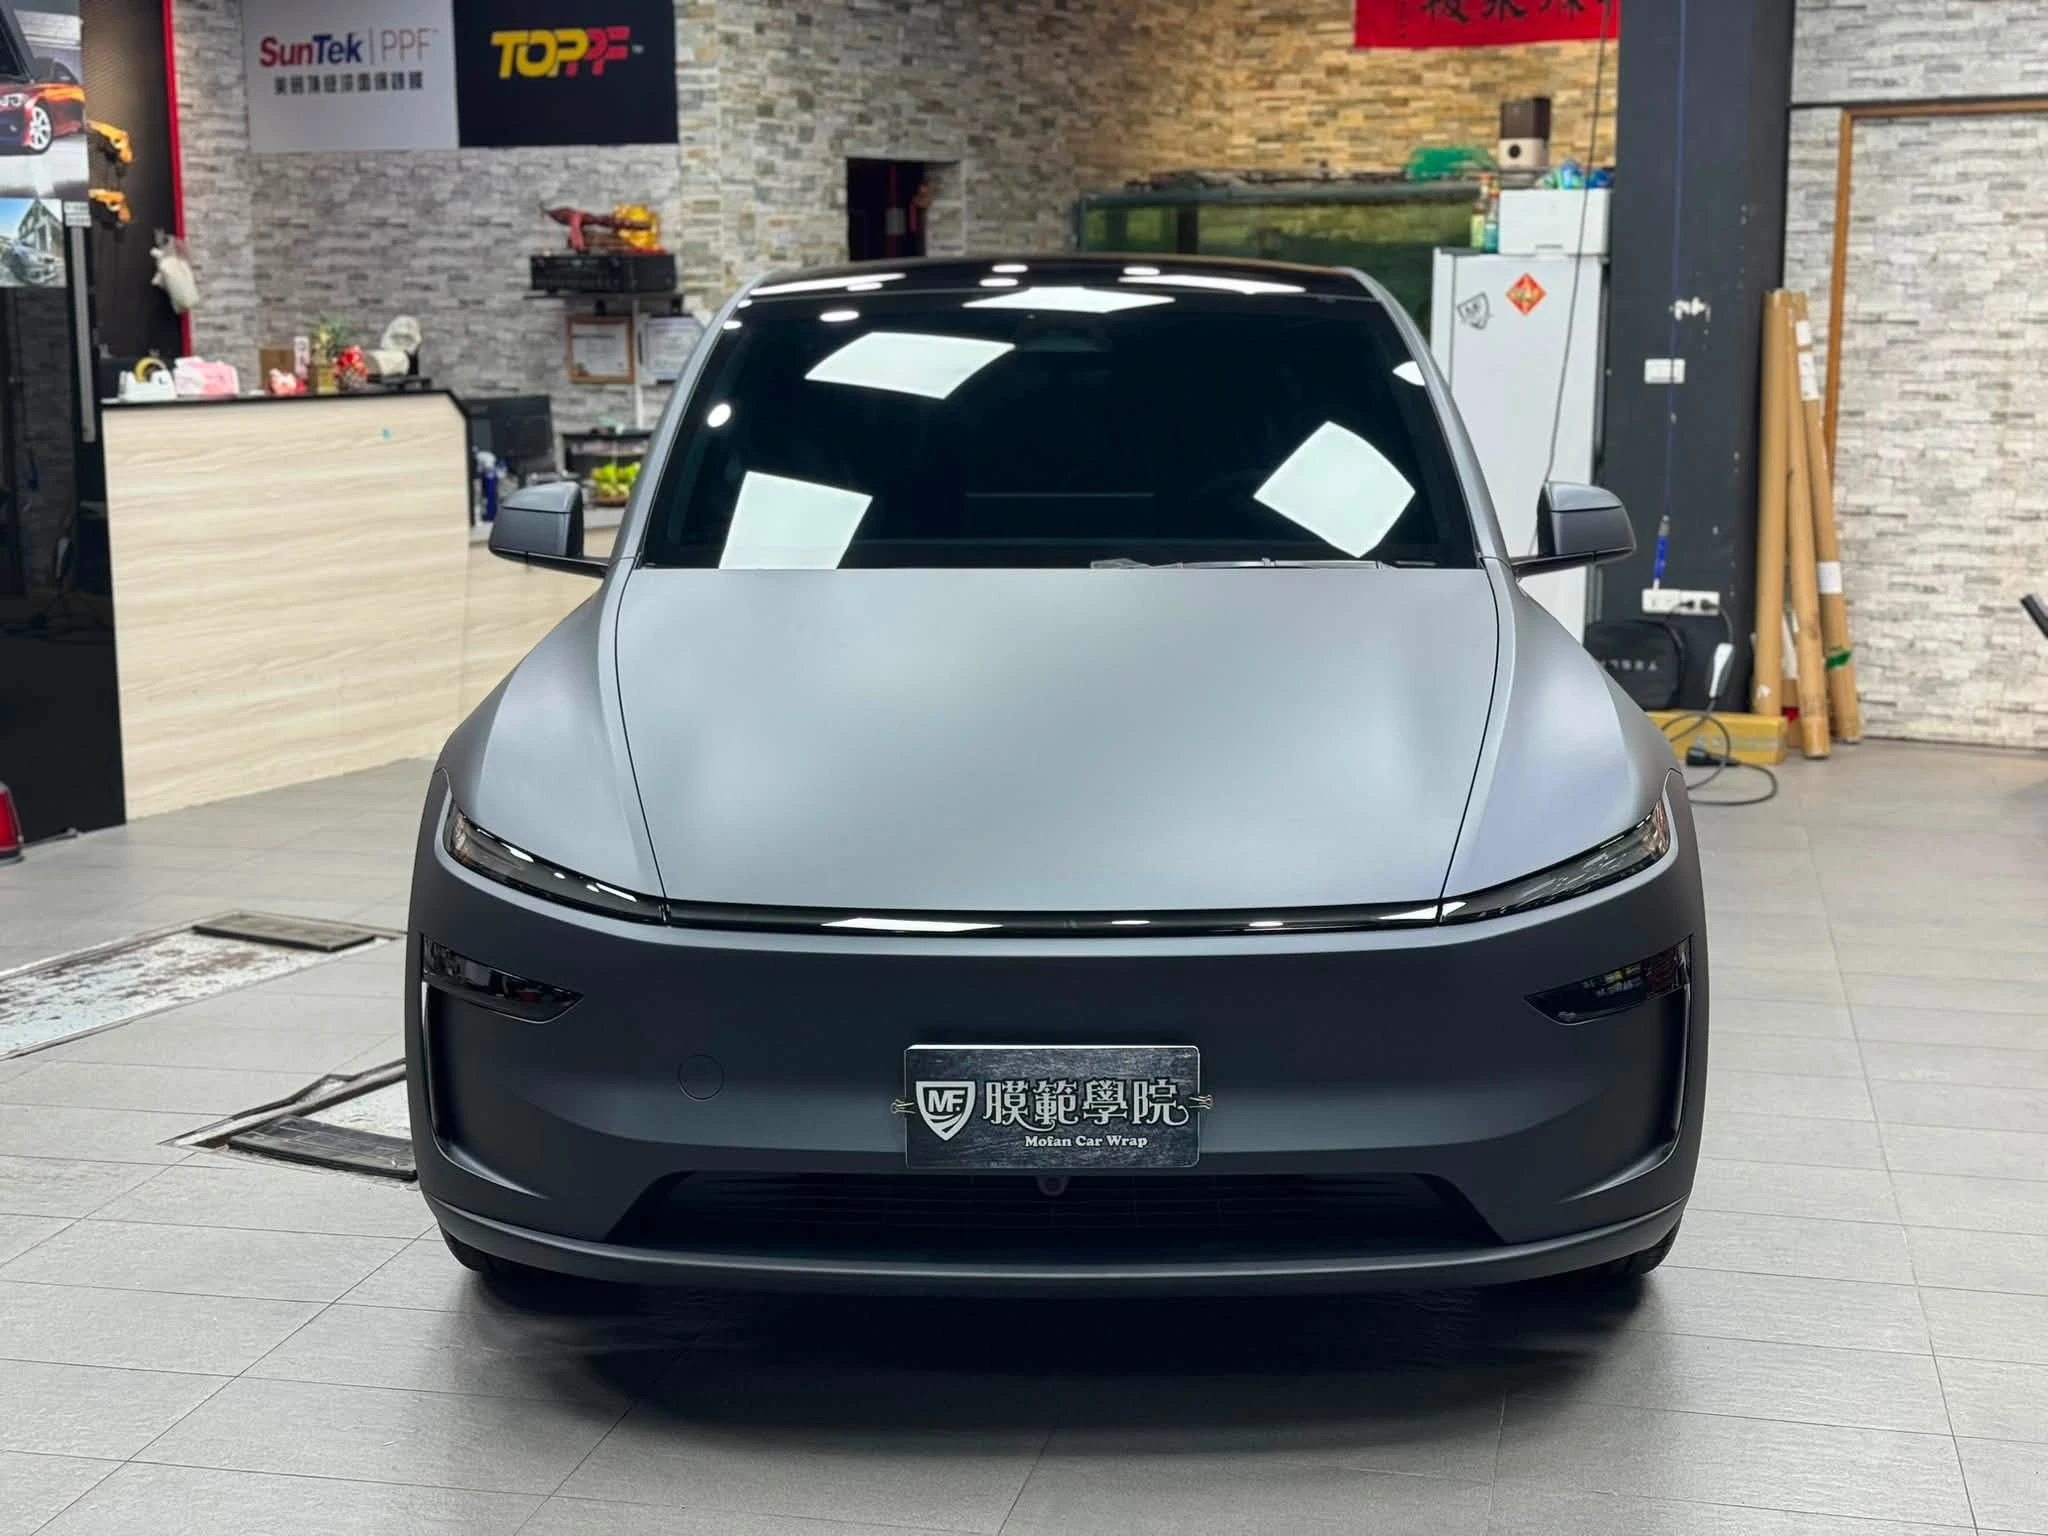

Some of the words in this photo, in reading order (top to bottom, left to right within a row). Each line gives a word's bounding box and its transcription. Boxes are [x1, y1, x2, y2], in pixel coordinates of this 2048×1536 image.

[259, 32, 363, 67] SunTek
[982, 1079, 1190, 1132] 膜範學院
[1025, 1135, 1072, 1147] Mofan
[1076, 1135, 1103, 1147] Car
[1106, 1135, 1148, 1149] Wrap
